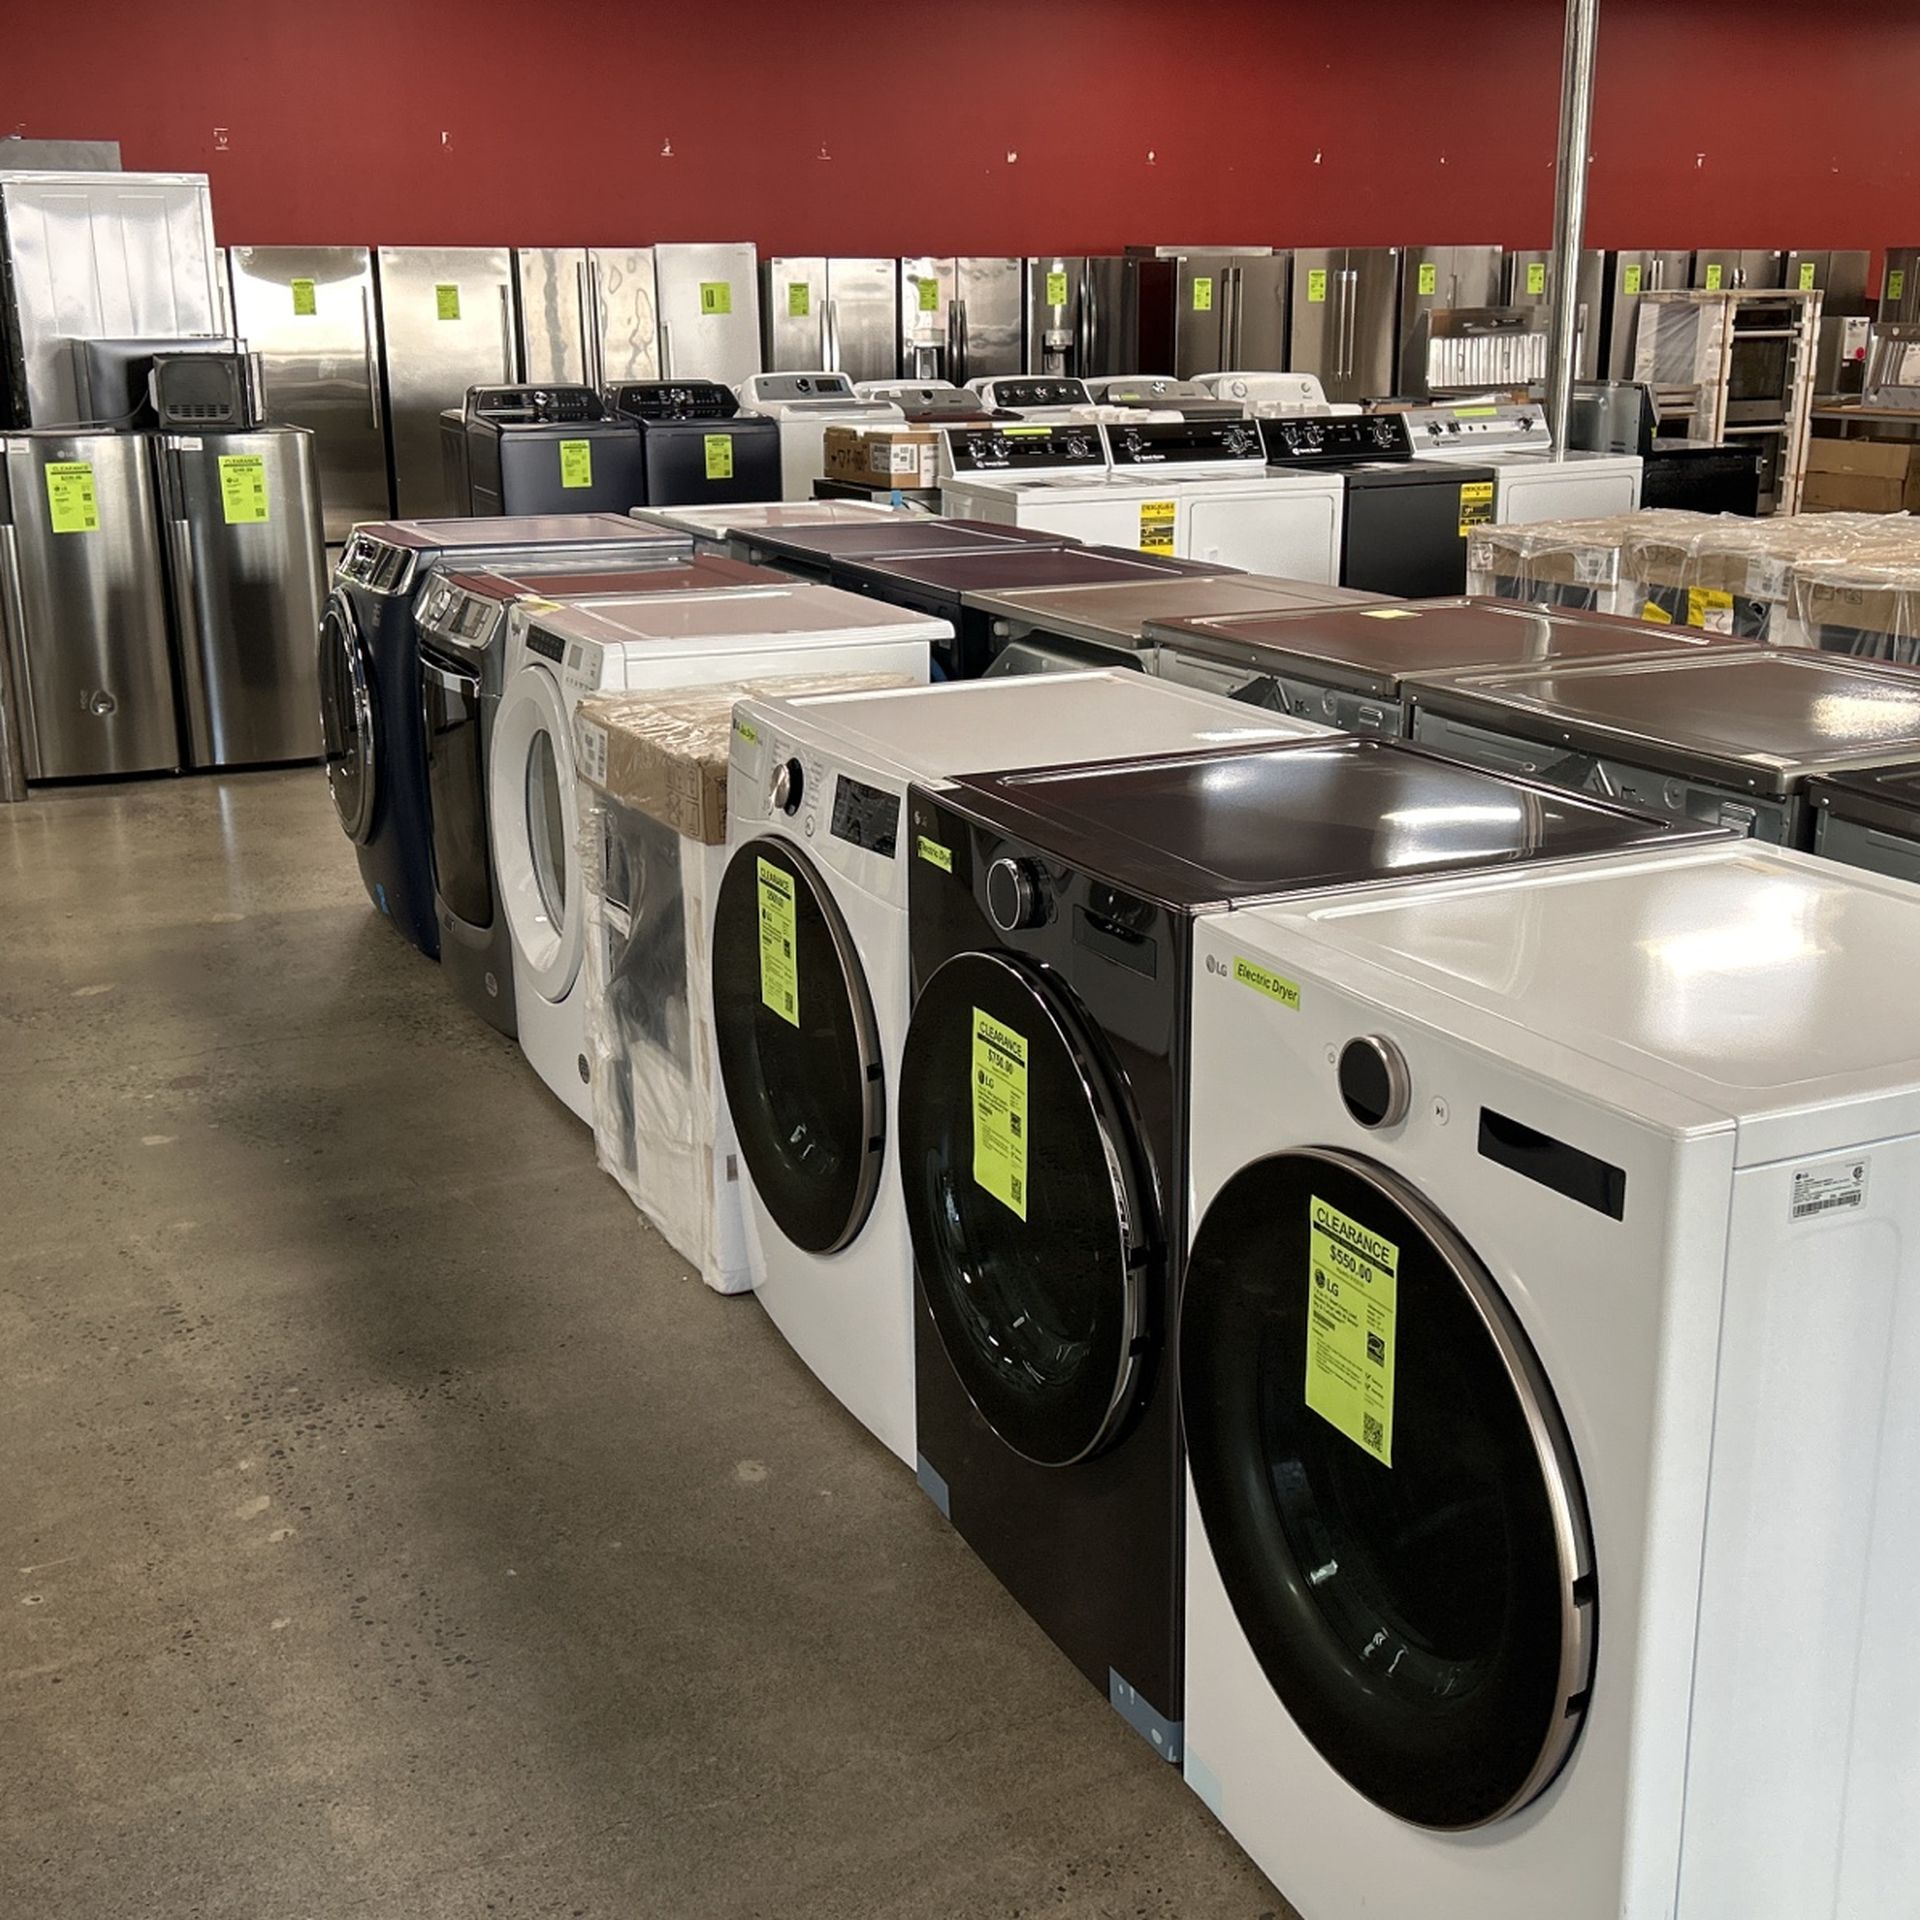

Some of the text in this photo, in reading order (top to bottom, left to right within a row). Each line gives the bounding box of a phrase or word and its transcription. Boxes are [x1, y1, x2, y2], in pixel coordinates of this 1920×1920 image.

[1216, 961, 1228, 977] LG
[1238, 963, 1297, 1001] Electric Dryer
[979, 1021, 1022, 1058] CLEARANCE
[984, 1075, 995, 1090] LG
[1316, 1206, 1390, 1265] CLEARANCE
[1329, 1243, 1373, 1284] $550.00
[1326, 1277, 1339, 1297] LG
